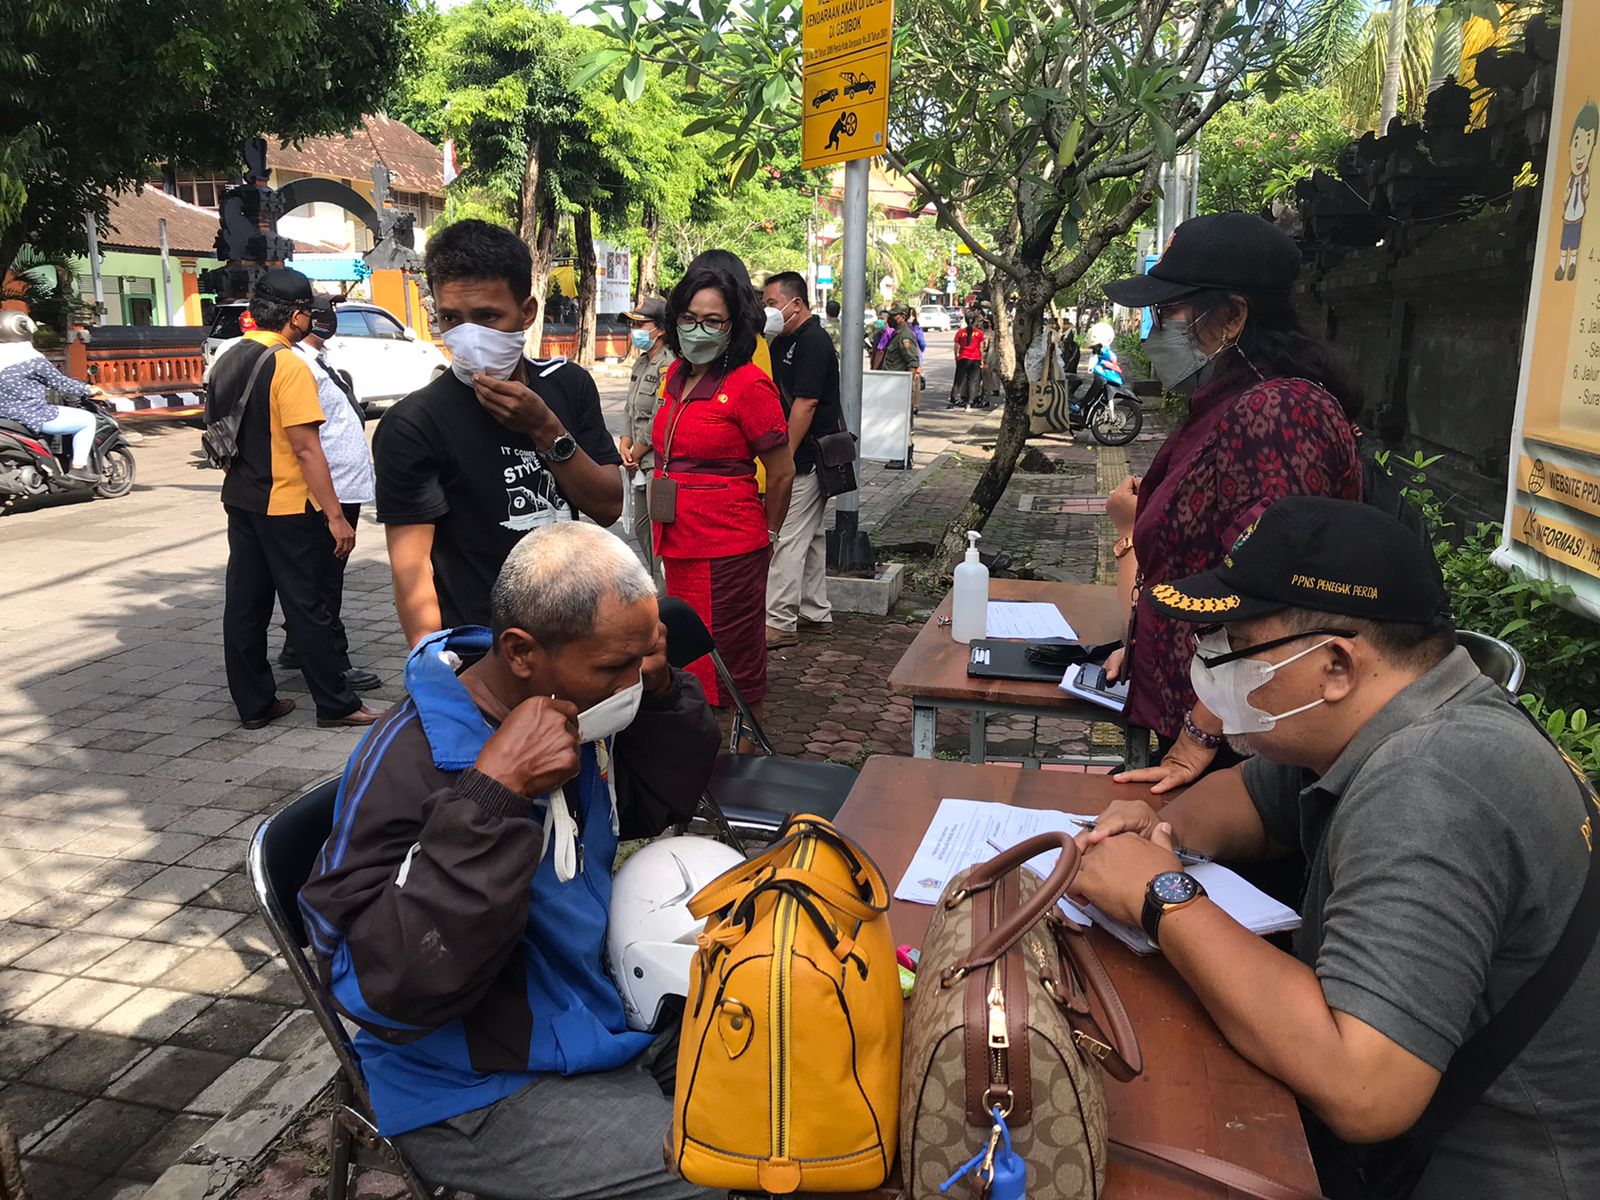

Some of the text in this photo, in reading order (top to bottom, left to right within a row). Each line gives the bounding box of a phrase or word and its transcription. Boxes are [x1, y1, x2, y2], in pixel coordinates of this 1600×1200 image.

[806, 4, 840, 28] KENDARAAN
[841, 0, 858, 16] AKAN
[829, 25, 836, 39] DI
[836, 16, 862, 36] GEMBOK
[501, 446, 511, 455] IT
[503, 459, 541, 484] STYLE
[1549, 471, 1581, 498] WEBSITE
[1536, 524, 1585, 558] INFORMASI
[1291, 574, 1378, 600] PPNS PENEGAK PERDA
